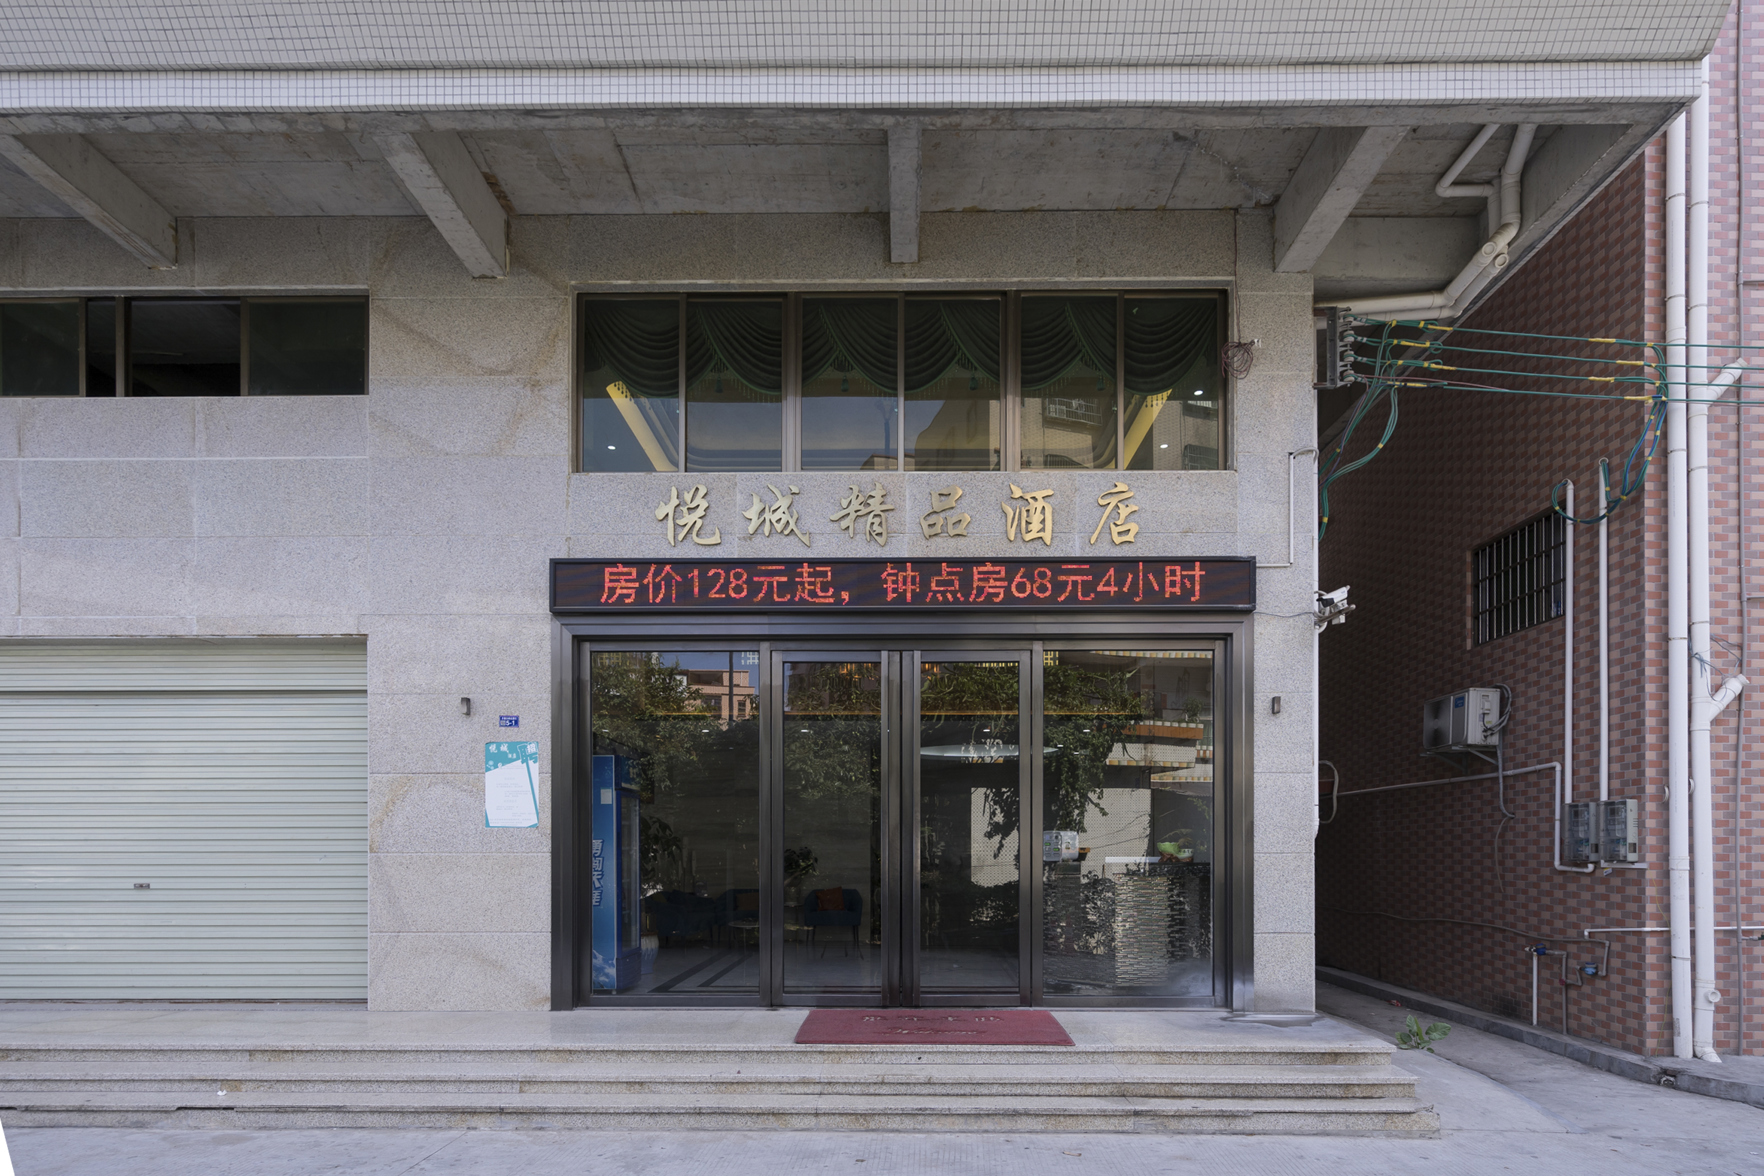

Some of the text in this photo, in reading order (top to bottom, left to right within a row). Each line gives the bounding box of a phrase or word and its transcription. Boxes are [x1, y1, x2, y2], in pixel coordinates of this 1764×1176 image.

[655, 481, 1141, 547] 悦城精品酒店
[600, 561, 1206, 606] 房价128元起，钟点房68元4小时
